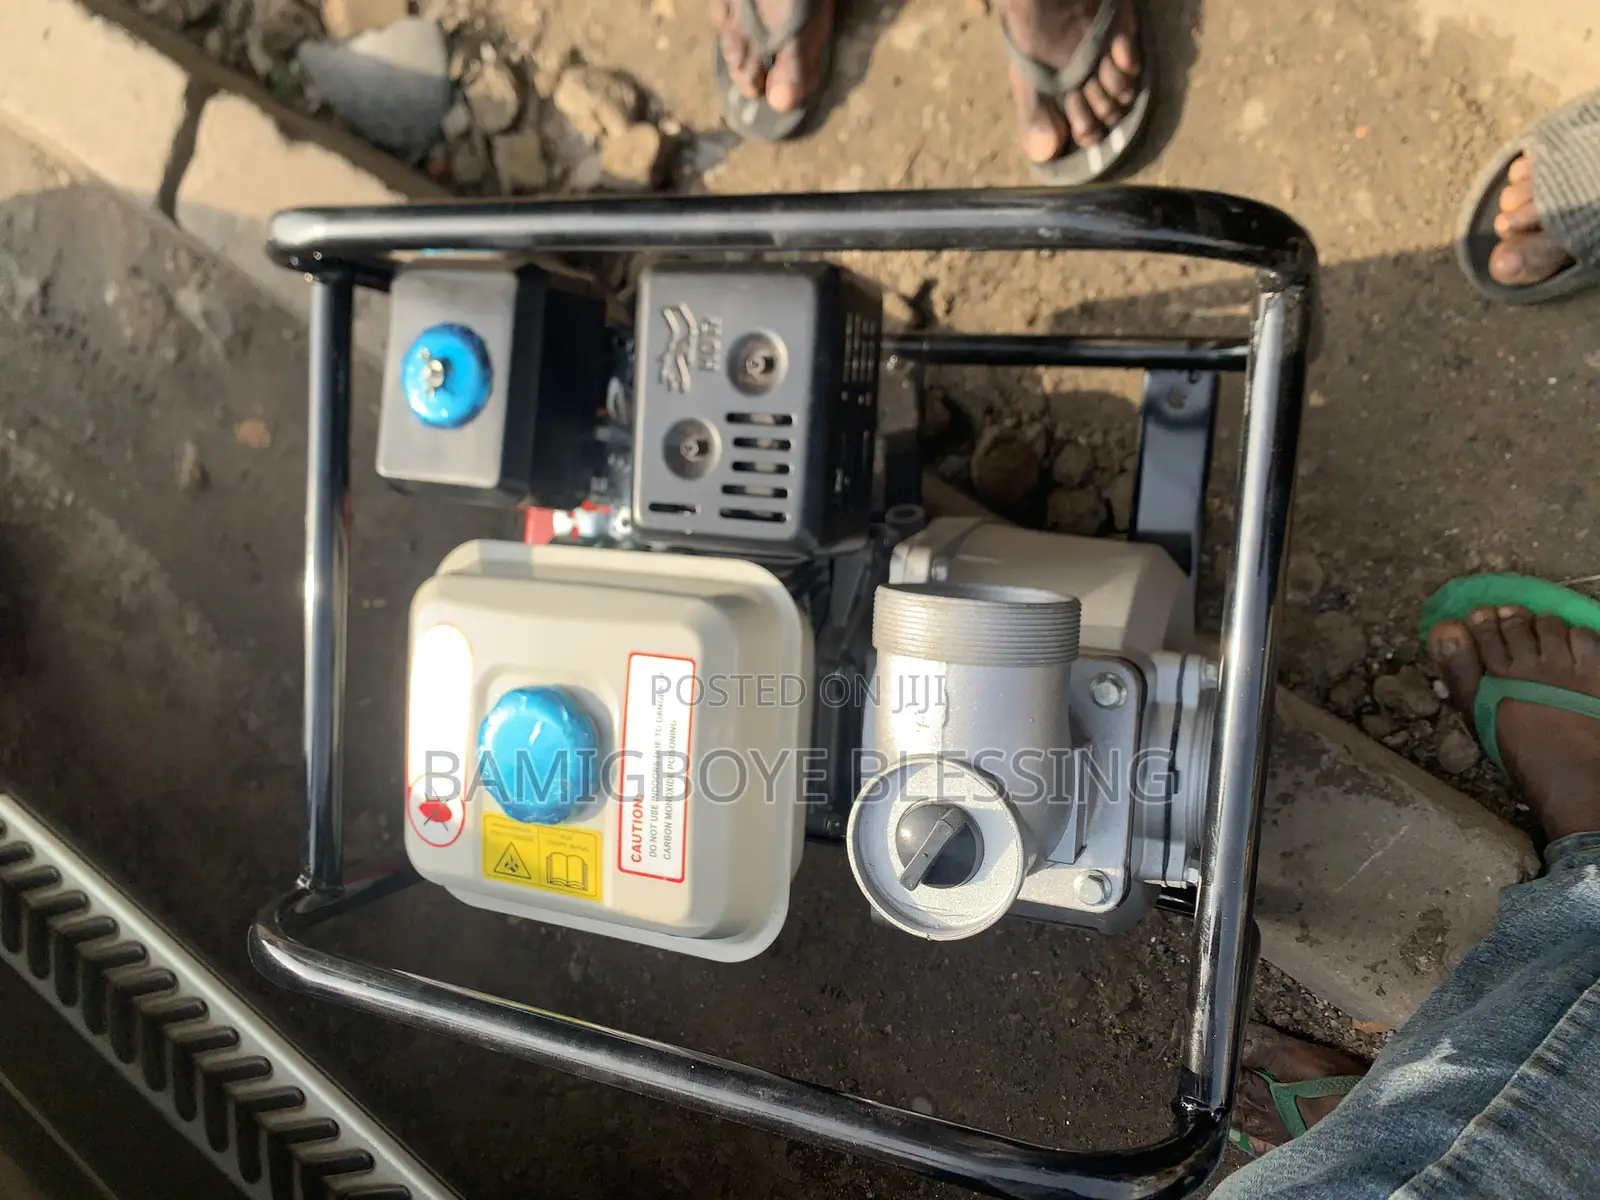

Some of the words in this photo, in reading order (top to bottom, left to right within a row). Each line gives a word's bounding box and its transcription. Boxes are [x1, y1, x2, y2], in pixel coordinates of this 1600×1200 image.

[650, 804, 659, 822] USE
[649, 823, 658, 843] NOT
[664, 822, 672, 860] CARBON
[649, 844, 657, 857] DO
